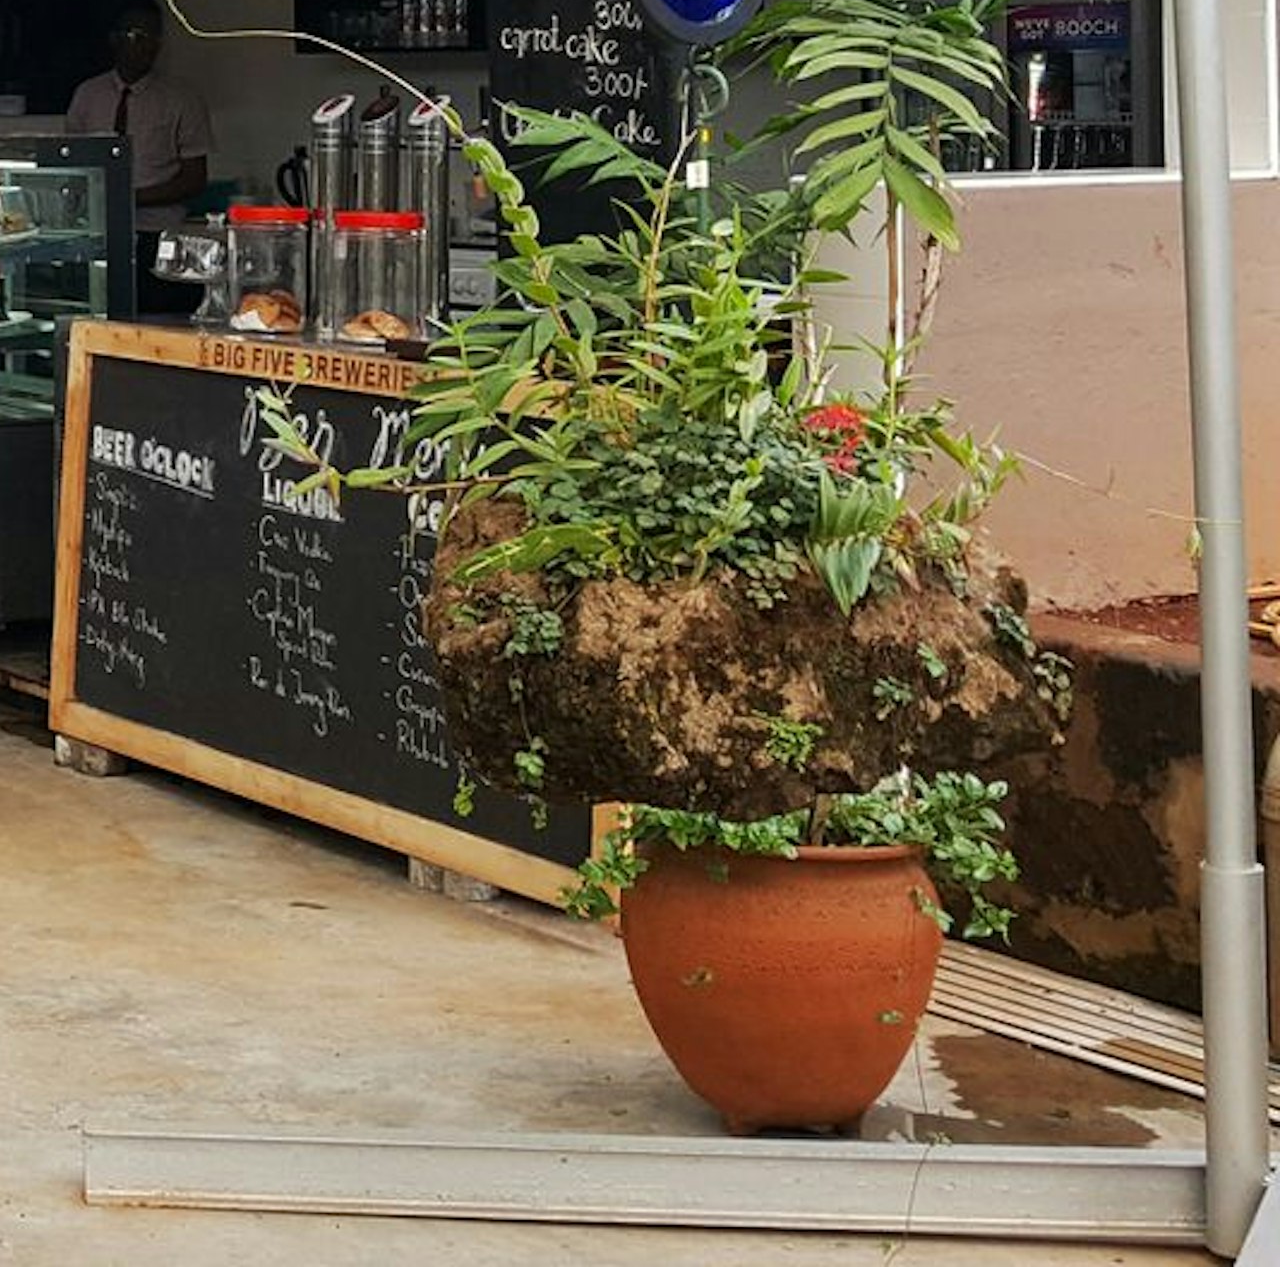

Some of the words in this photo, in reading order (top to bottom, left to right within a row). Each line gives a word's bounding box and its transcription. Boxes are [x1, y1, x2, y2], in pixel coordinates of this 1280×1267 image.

[1054, 18, 1119, 35] BOOCH
[214, 342, 246, 370] BIG
[251, 348, 294, 377] FIVE
[92, 425, 138, 469] BEER
